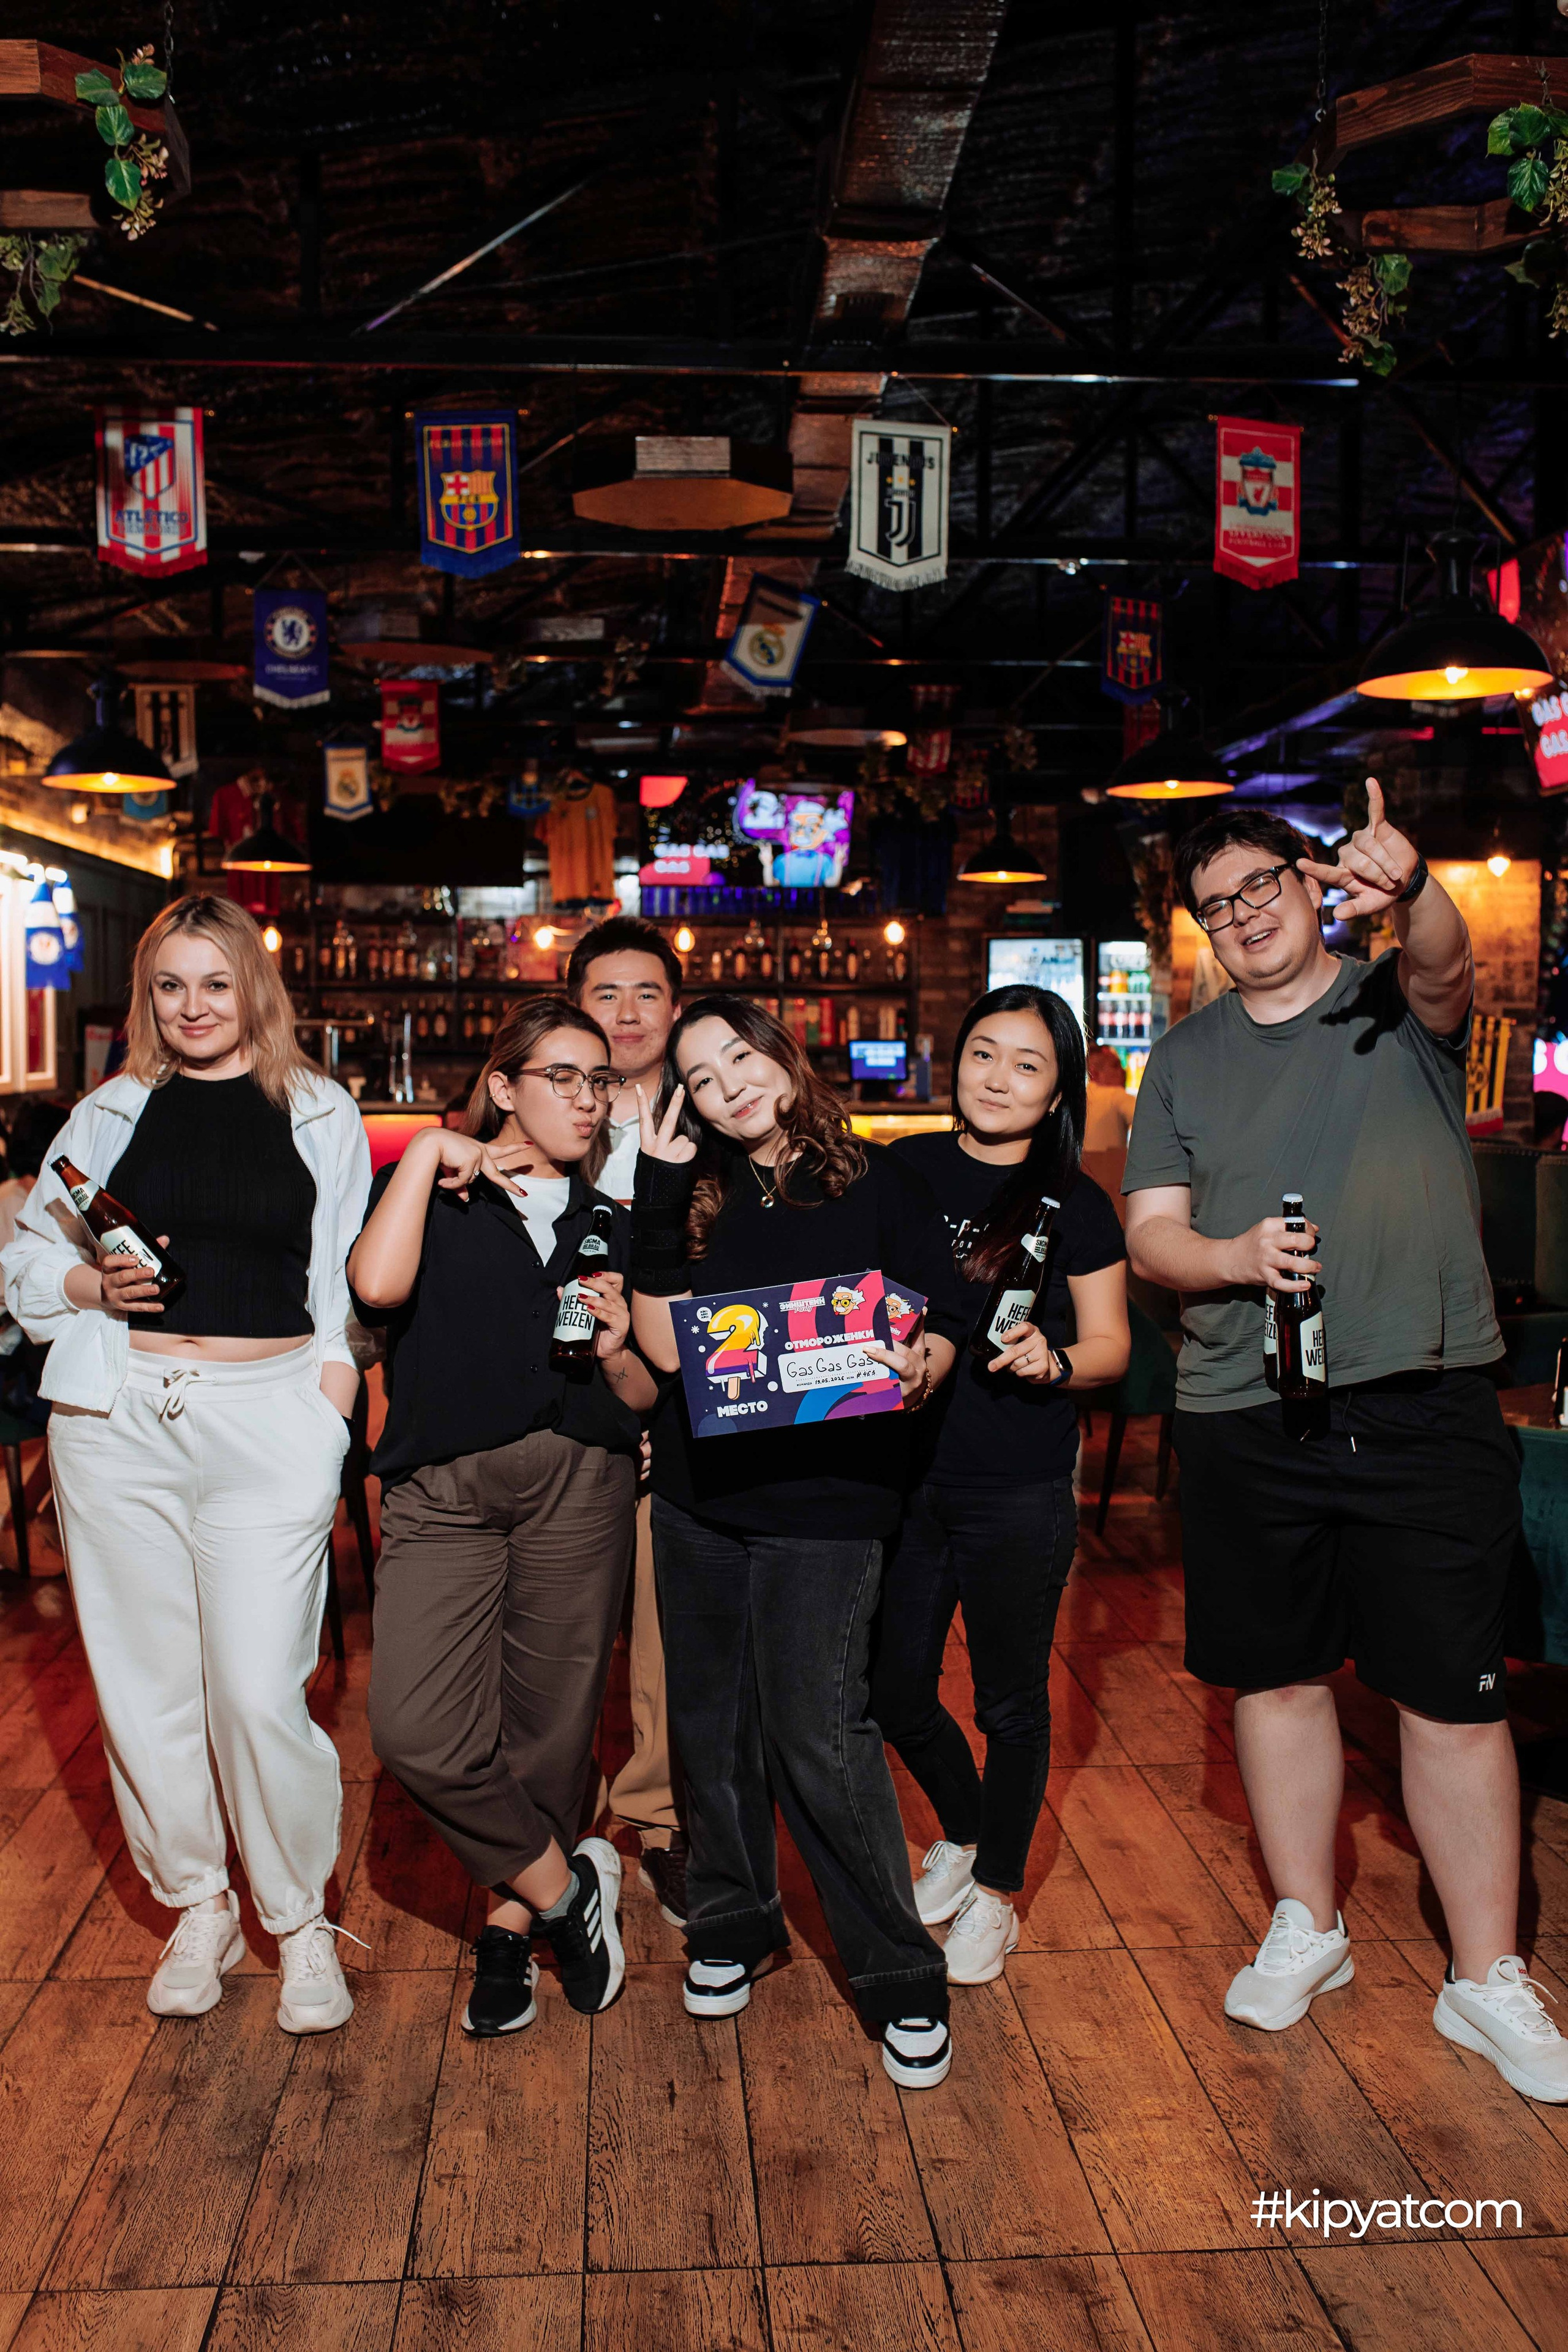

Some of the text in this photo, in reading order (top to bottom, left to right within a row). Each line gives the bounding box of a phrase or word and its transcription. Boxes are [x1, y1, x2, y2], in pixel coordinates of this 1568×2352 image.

[785, 1329, 874, 1351] ОТМОРОЖЕНКИ
[786, 1362, 813, 1378] Gas
[816, 1357, 842, 1372] Gas
[717, 1400, 768, 1418] МЕСТО
